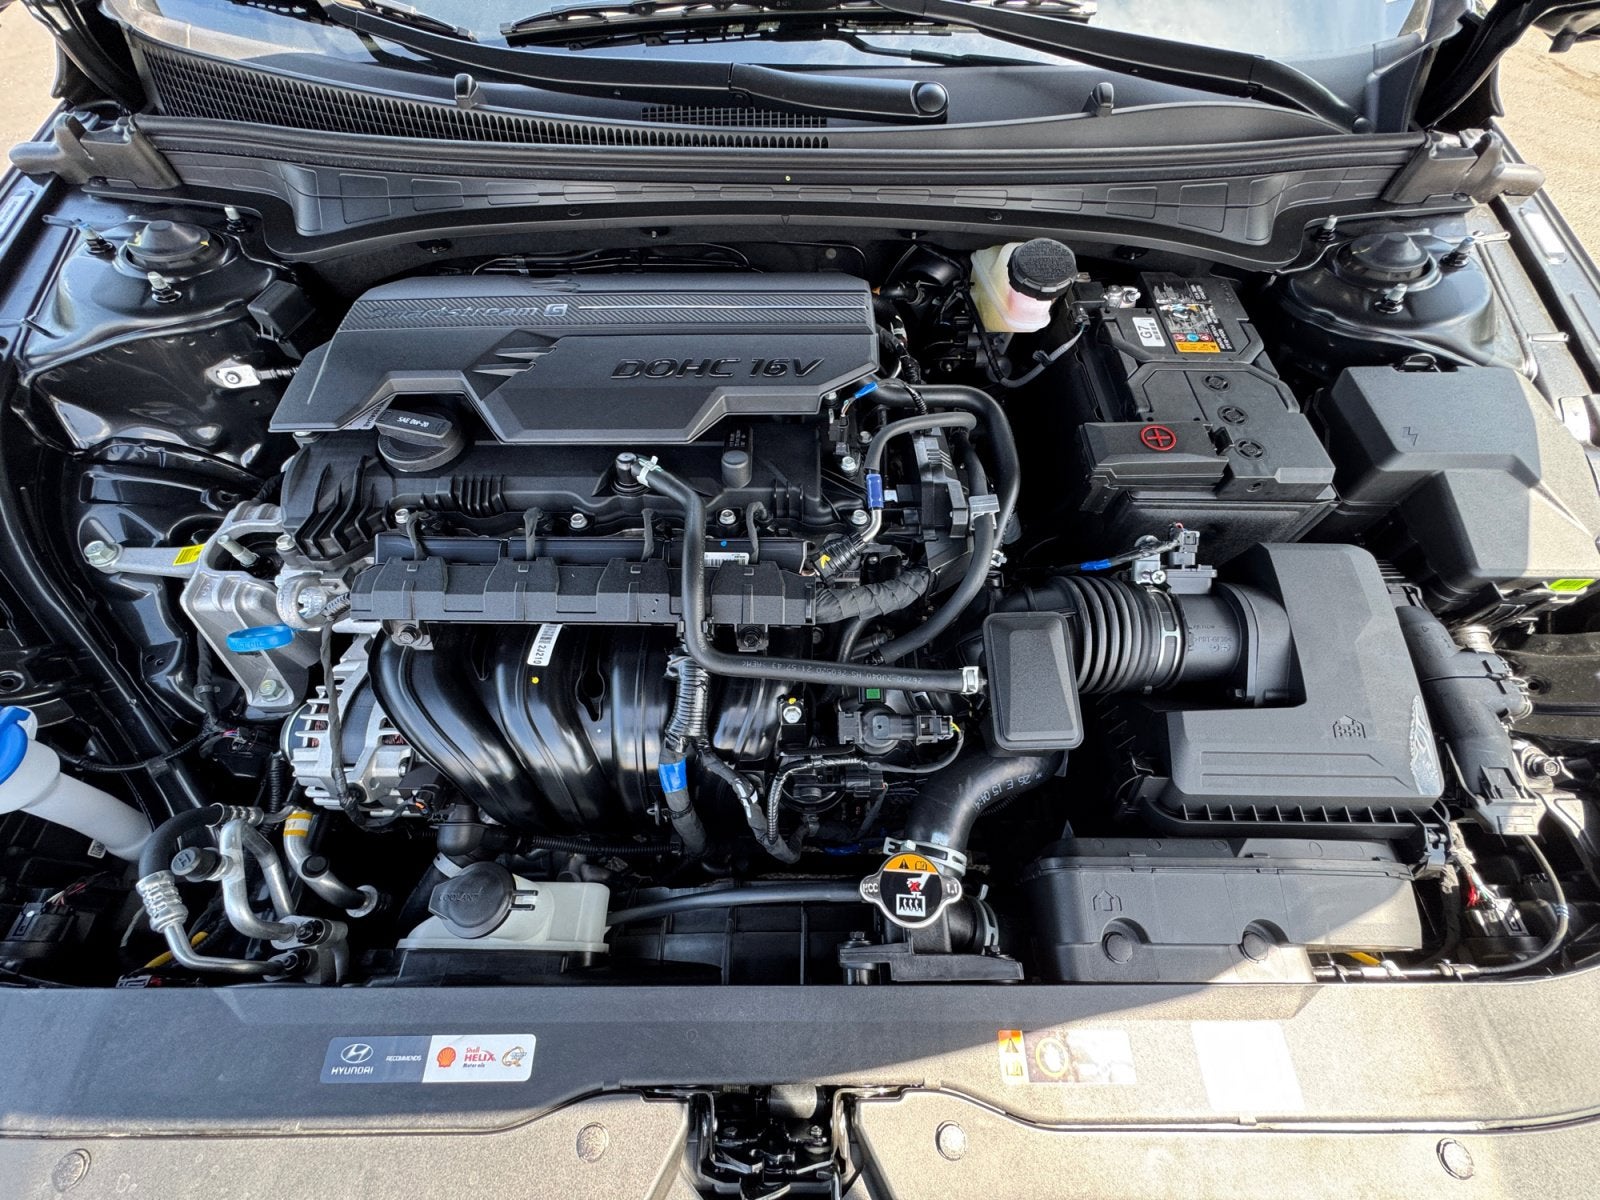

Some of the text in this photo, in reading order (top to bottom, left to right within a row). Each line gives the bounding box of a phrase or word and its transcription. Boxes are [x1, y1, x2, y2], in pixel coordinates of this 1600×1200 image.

[1138, 325, 1153, 339] G7
[611, 357, 825, 379] DOHC 16V
[1006, 780, 1014, 790] E
[1018, 774, 1031, 786] 26
[991, 783, 1003, 796] 15
[946, 883, 958, 894] 1.1
[465, 1046, 481, 1054] Shell
[464, 1053, 496, 1062] HELIX
[331, 1066, 374, 1076] HYUNDAI
